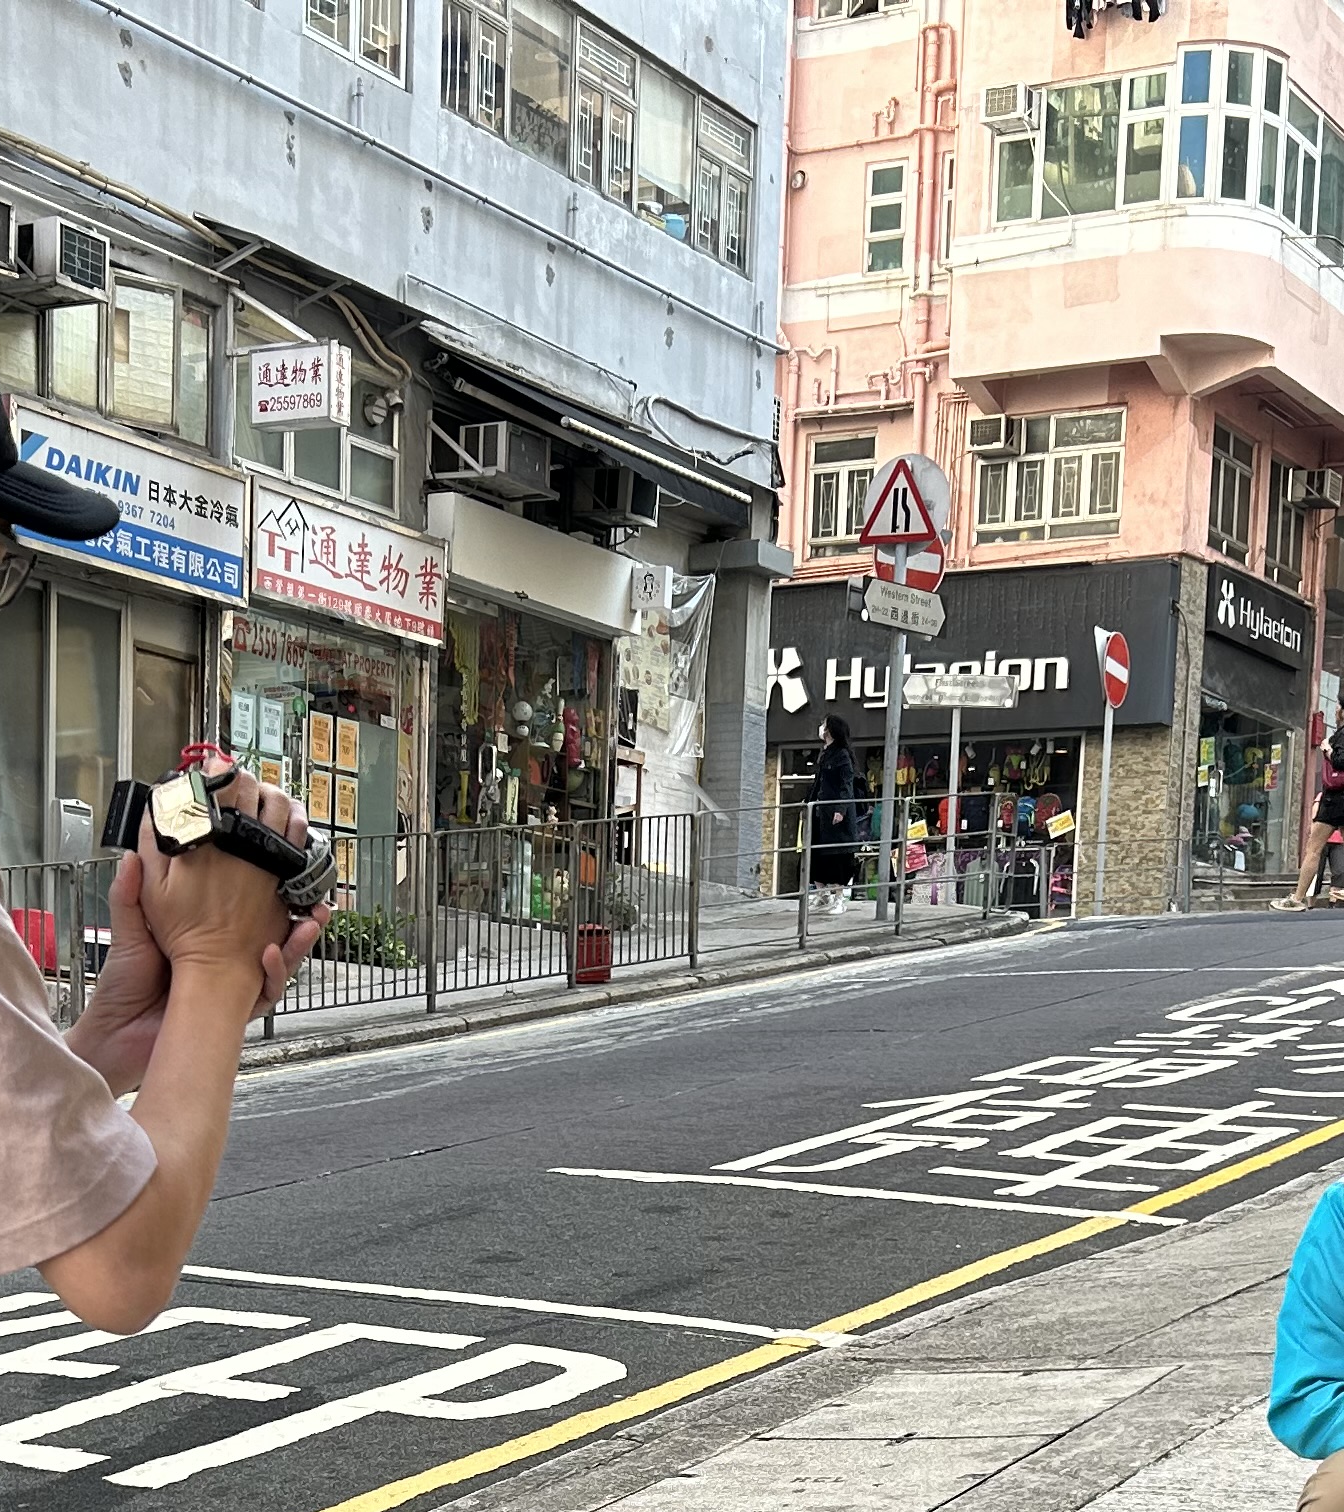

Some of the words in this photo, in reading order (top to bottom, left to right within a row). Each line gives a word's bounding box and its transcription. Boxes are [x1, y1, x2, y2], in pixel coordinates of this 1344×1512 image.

[258, 356, 324, 387] 通達物業
[270, 392, 323, 412] 25597869
[45, 447, 141, 497] DAIKIN
[117, 500, 145, 520] 9367
[150, 512, 176, 531] 7204
[148, 479, 240, 529] 日本大金冷氣
[84, 528, 240, 589] 冷氣工程有限公司
[309, 524, 443, 611] 通達物業
[880, 586, 909, 602] Western
[910, 593, 932, 608] Street
[1239, 597, 1301, 653] Hylaeion
[354, 653, 396, 680] PROPERTY
[711, 1086, 1338, 1197] 停車
